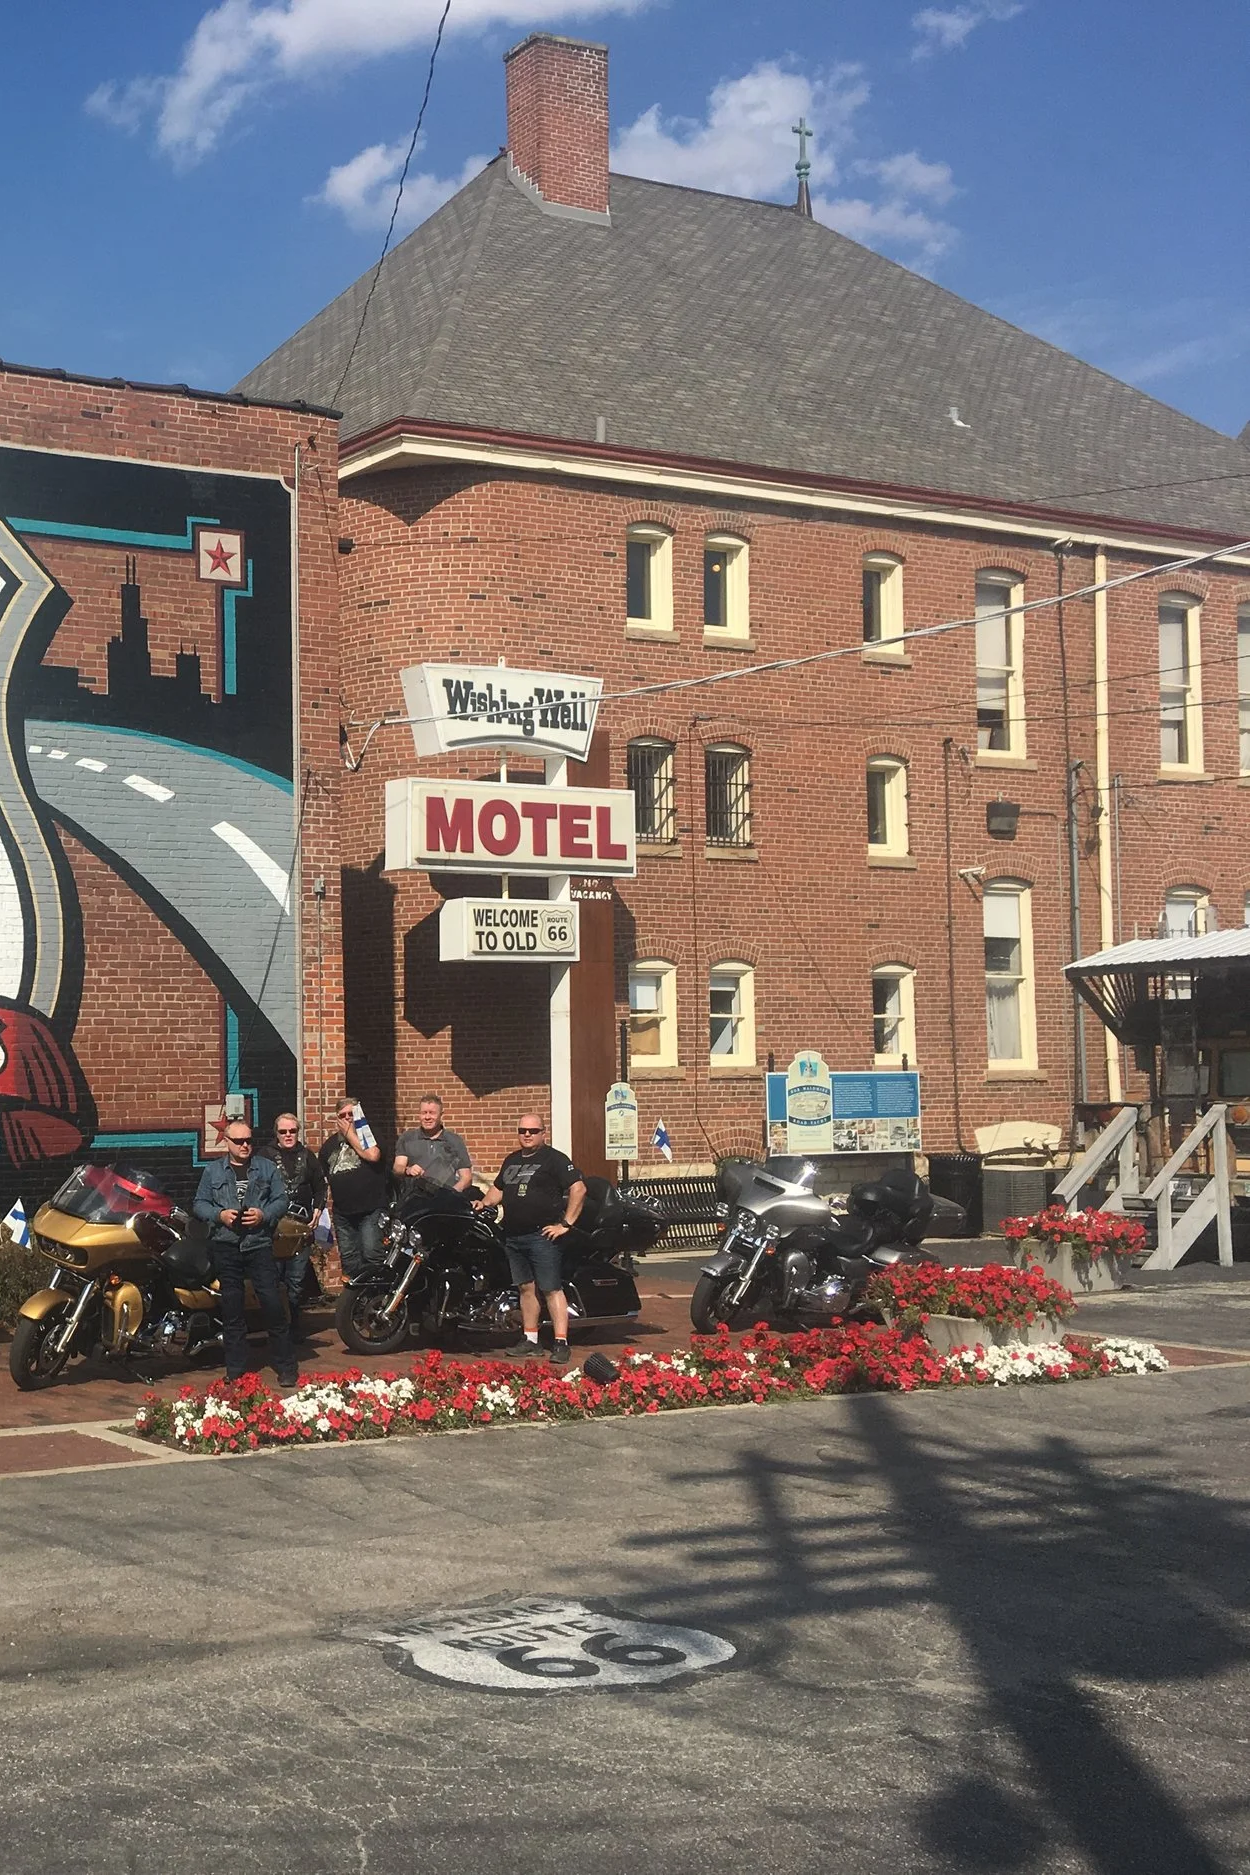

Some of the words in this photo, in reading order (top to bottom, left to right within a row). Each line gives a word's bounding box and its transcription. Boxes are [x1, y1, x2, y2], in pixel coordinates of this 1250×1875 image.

[442, 678, 535, 737] Wishing
[534, 687, 588, 732] Well
[425, 796, 628, 861] MOTEL
[570, 889, 612, 900] VACANCY
[473, 908, 539, 928] WELCOME
[475, 931, 498, 951] TO
[502, 931, 537, 951] OLD
[548, 926, 568, 941] 66
[440, 1620, 609, 1651] ROUTE
[496, 1632, 687, 1679] 66
